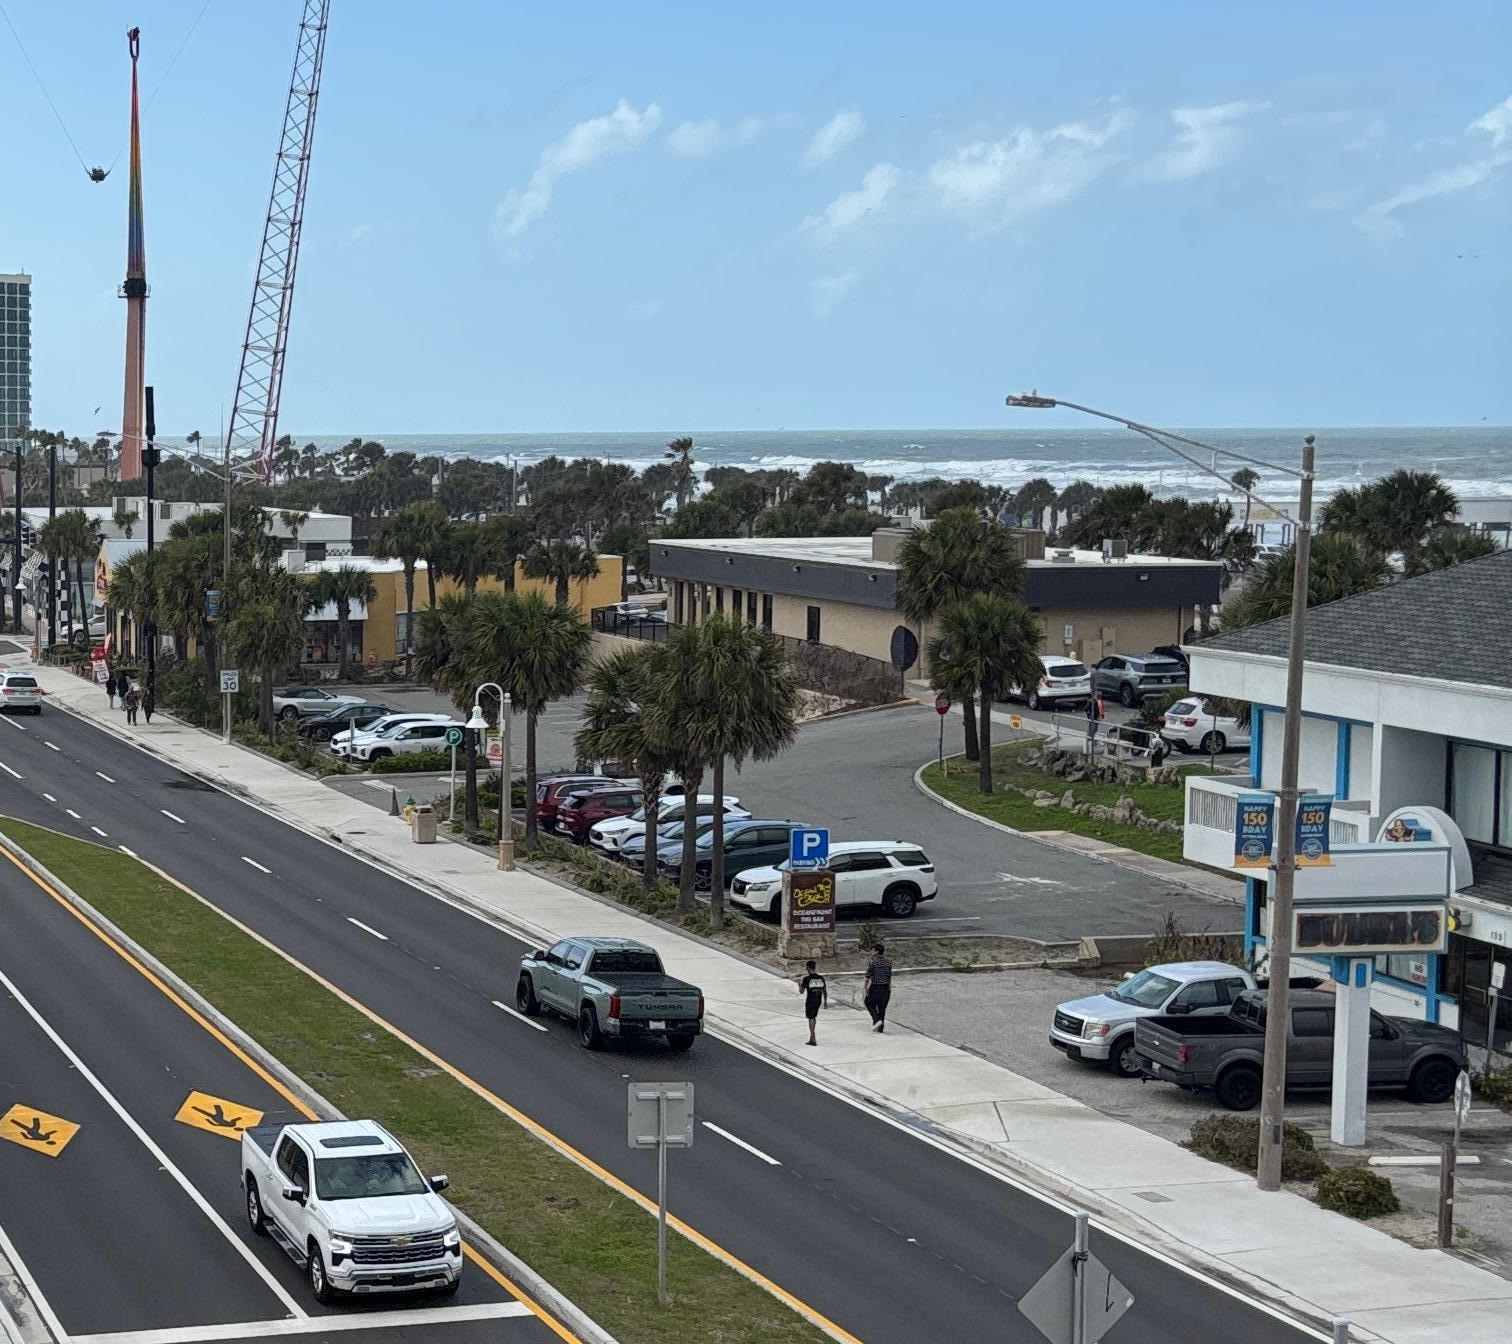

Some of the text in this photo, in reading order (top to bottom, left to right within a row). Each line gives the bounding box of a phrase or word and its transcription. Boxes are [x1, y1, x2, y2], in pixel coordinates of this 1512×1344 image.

[223, 682, 237, 690] 30
[449, 731, 459, 742] P
[1243, 812, 1267, 825] 150
[1302, 812, 1324, 824] 150
[1242, 826, 1267, 834] BDAY
[1301, 825, 1323, 833] BDAY
[802, 833, 821, 856] P
